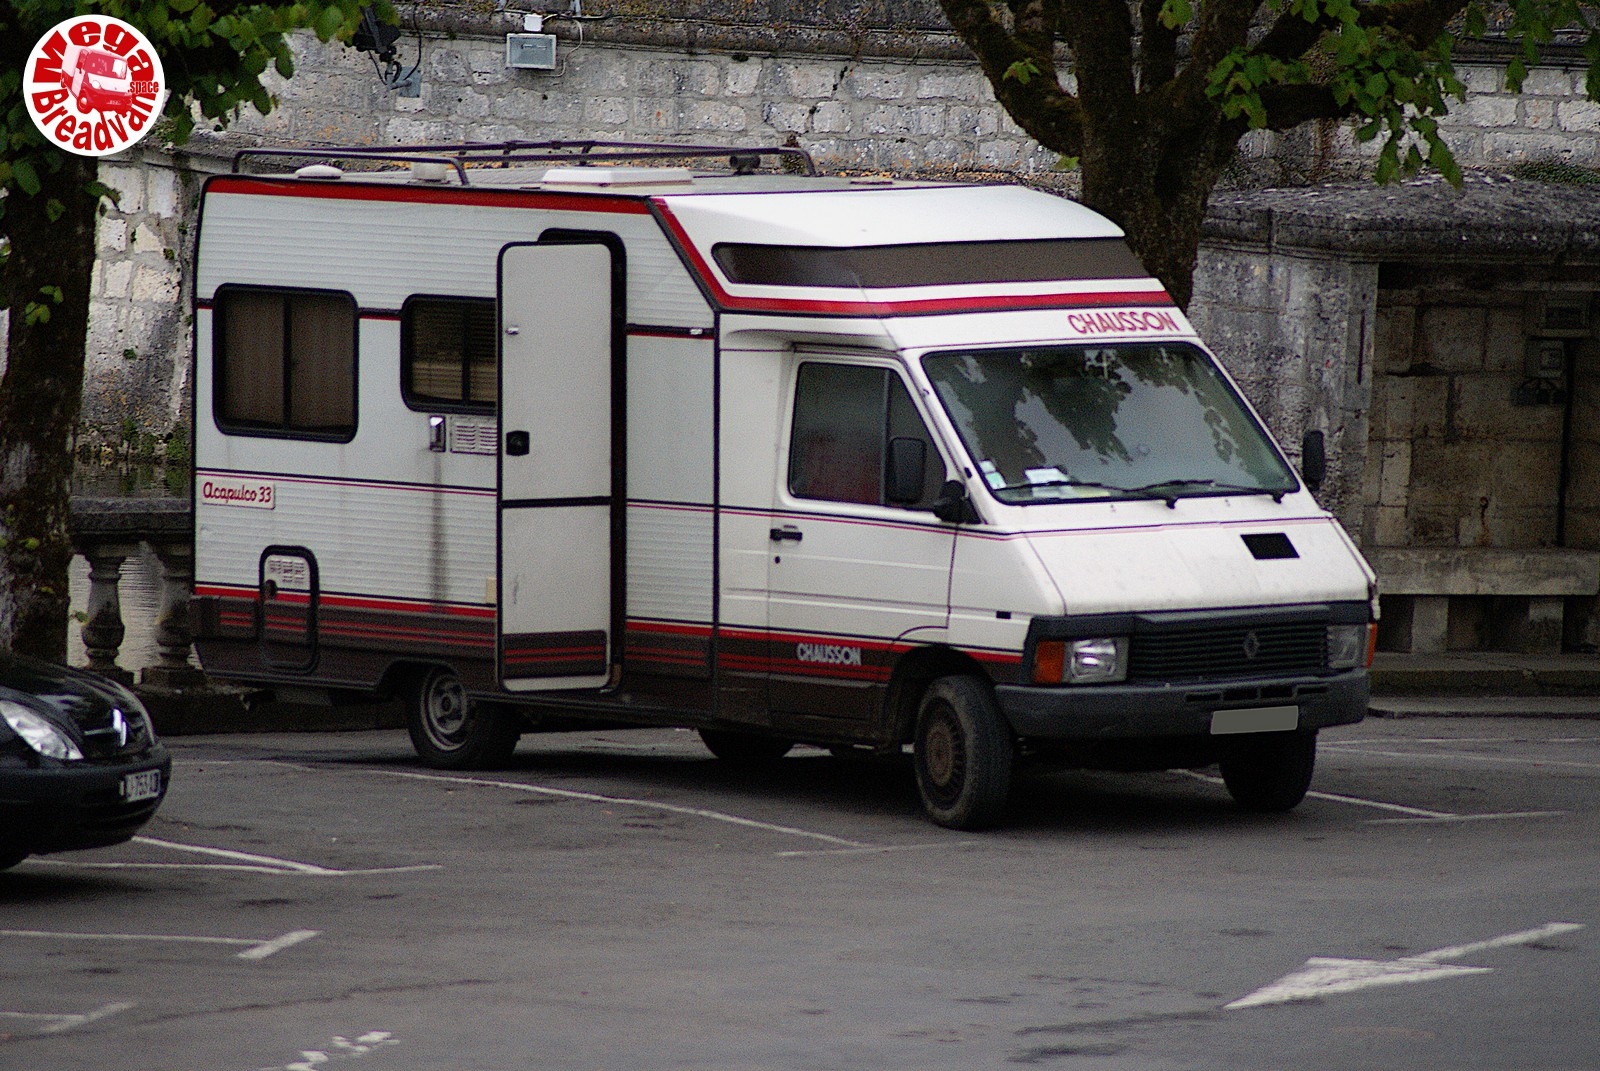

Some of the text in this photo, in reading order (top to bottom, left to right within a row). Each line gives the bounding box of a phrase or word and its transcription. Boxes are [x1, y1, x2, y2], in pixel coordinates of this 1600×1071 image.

[1067, 311, 1181, 335] CHAUSSON
[203, 481, 272, 503] Acapulco 33
[796, 642, 862, 666] CHAUSSON
